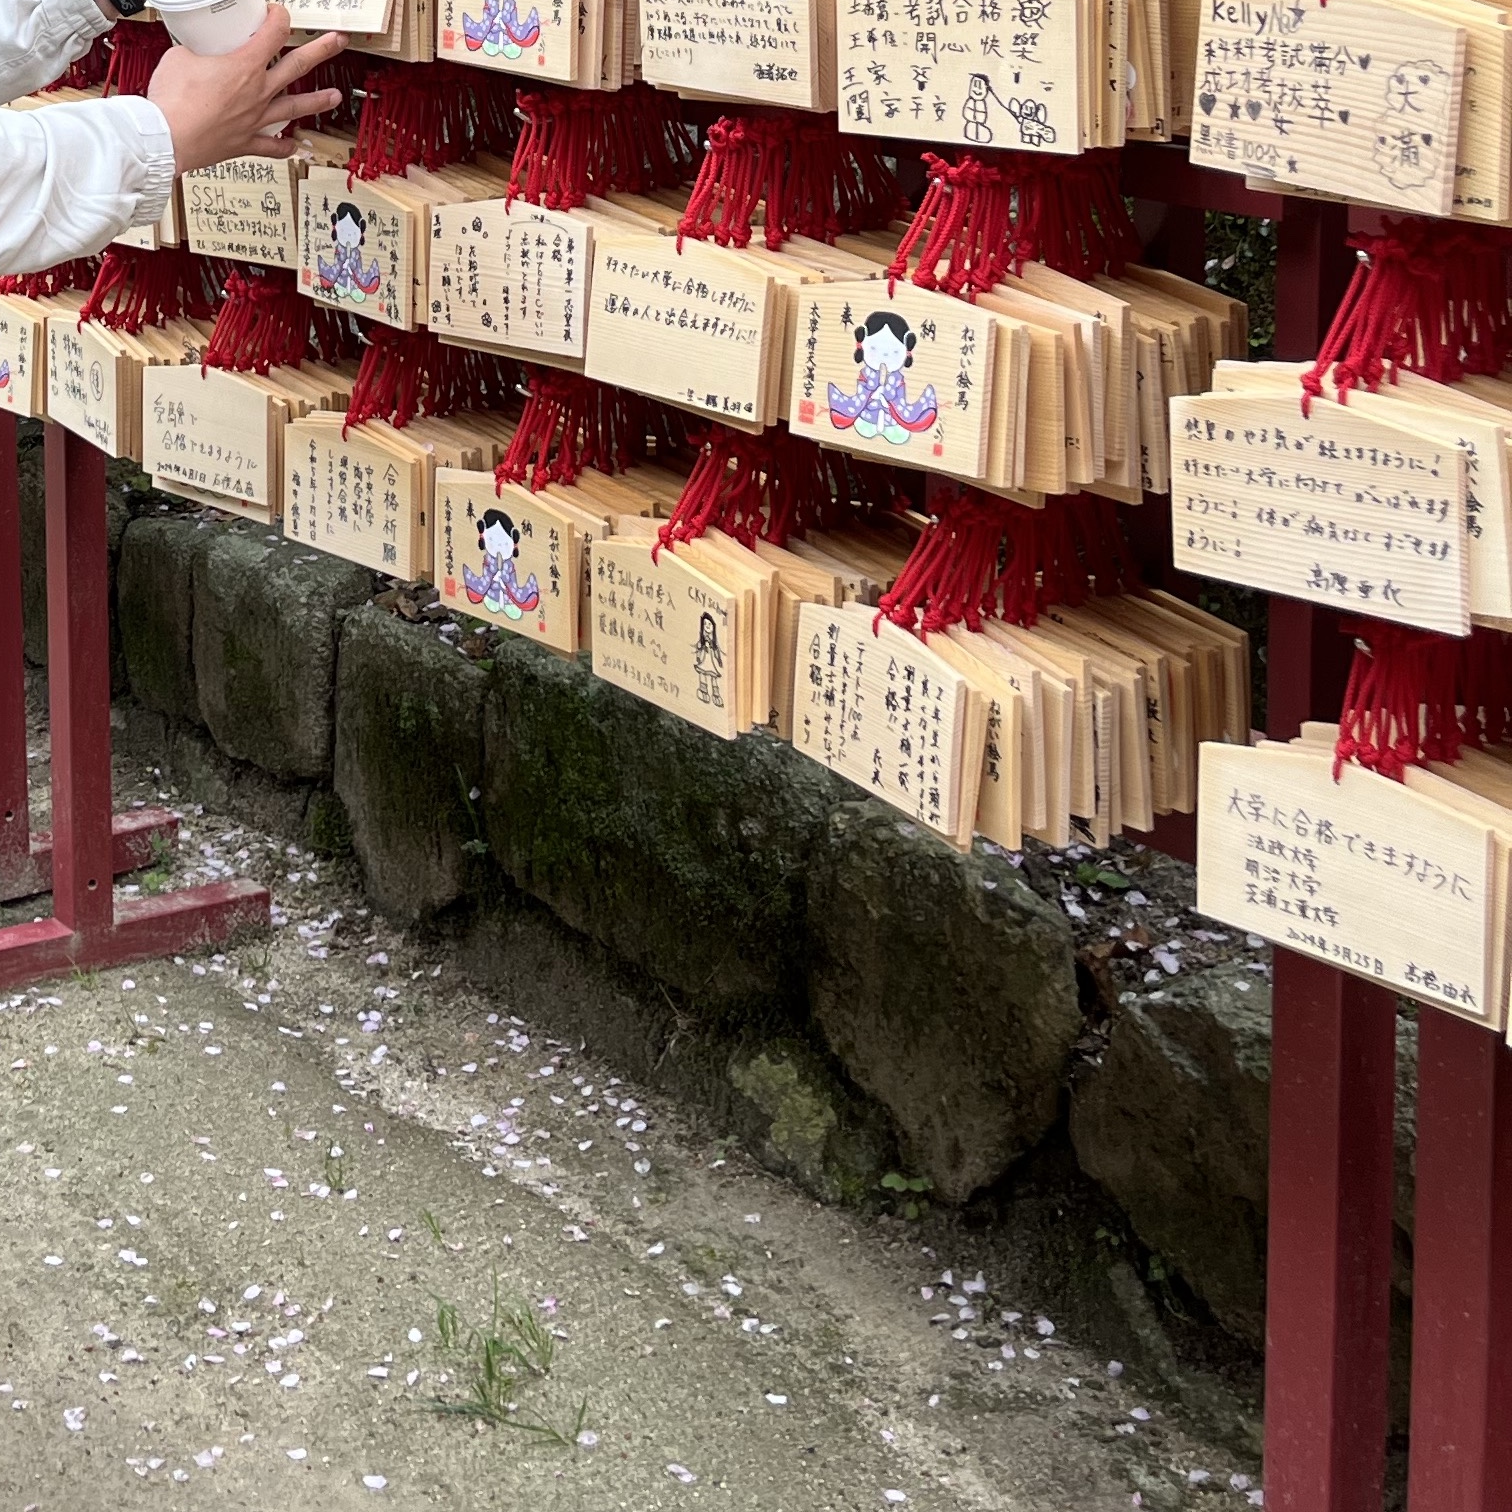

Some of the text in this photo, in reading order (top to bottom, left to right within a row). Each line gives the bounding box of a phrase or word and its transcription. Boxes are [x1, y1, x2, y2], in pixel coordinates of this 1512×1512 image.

[192, 184, 226, 208] SSH
[841, 301, 855, 332] 奉
[920, 319, 937, 341] 納
[803, 301, 821, 398] 太宰府天満宮
[955, 325, 976, 410] ねがい絵馬
[161, 430, 257, 470] 合格できますように
[382, 463, 400, 566] 合格祈願
[466, 497, 477, 524] 奉
[521, 518, 533, 538] 納
[444, 496, 454, 575] 太宰府天満宮
[549, 527, 560, 598] ねがい絵馬
[1227, 788, 1472, 901] 大学に合格できますように
[1247, 834, 1320, 873] 法政大学
[1244, 857, 1322, 897] 明治大学
[1244, 883, 1340, 927] 芝浦工業大学
[1286, 926, 1384, 976] 2024年3月25日
